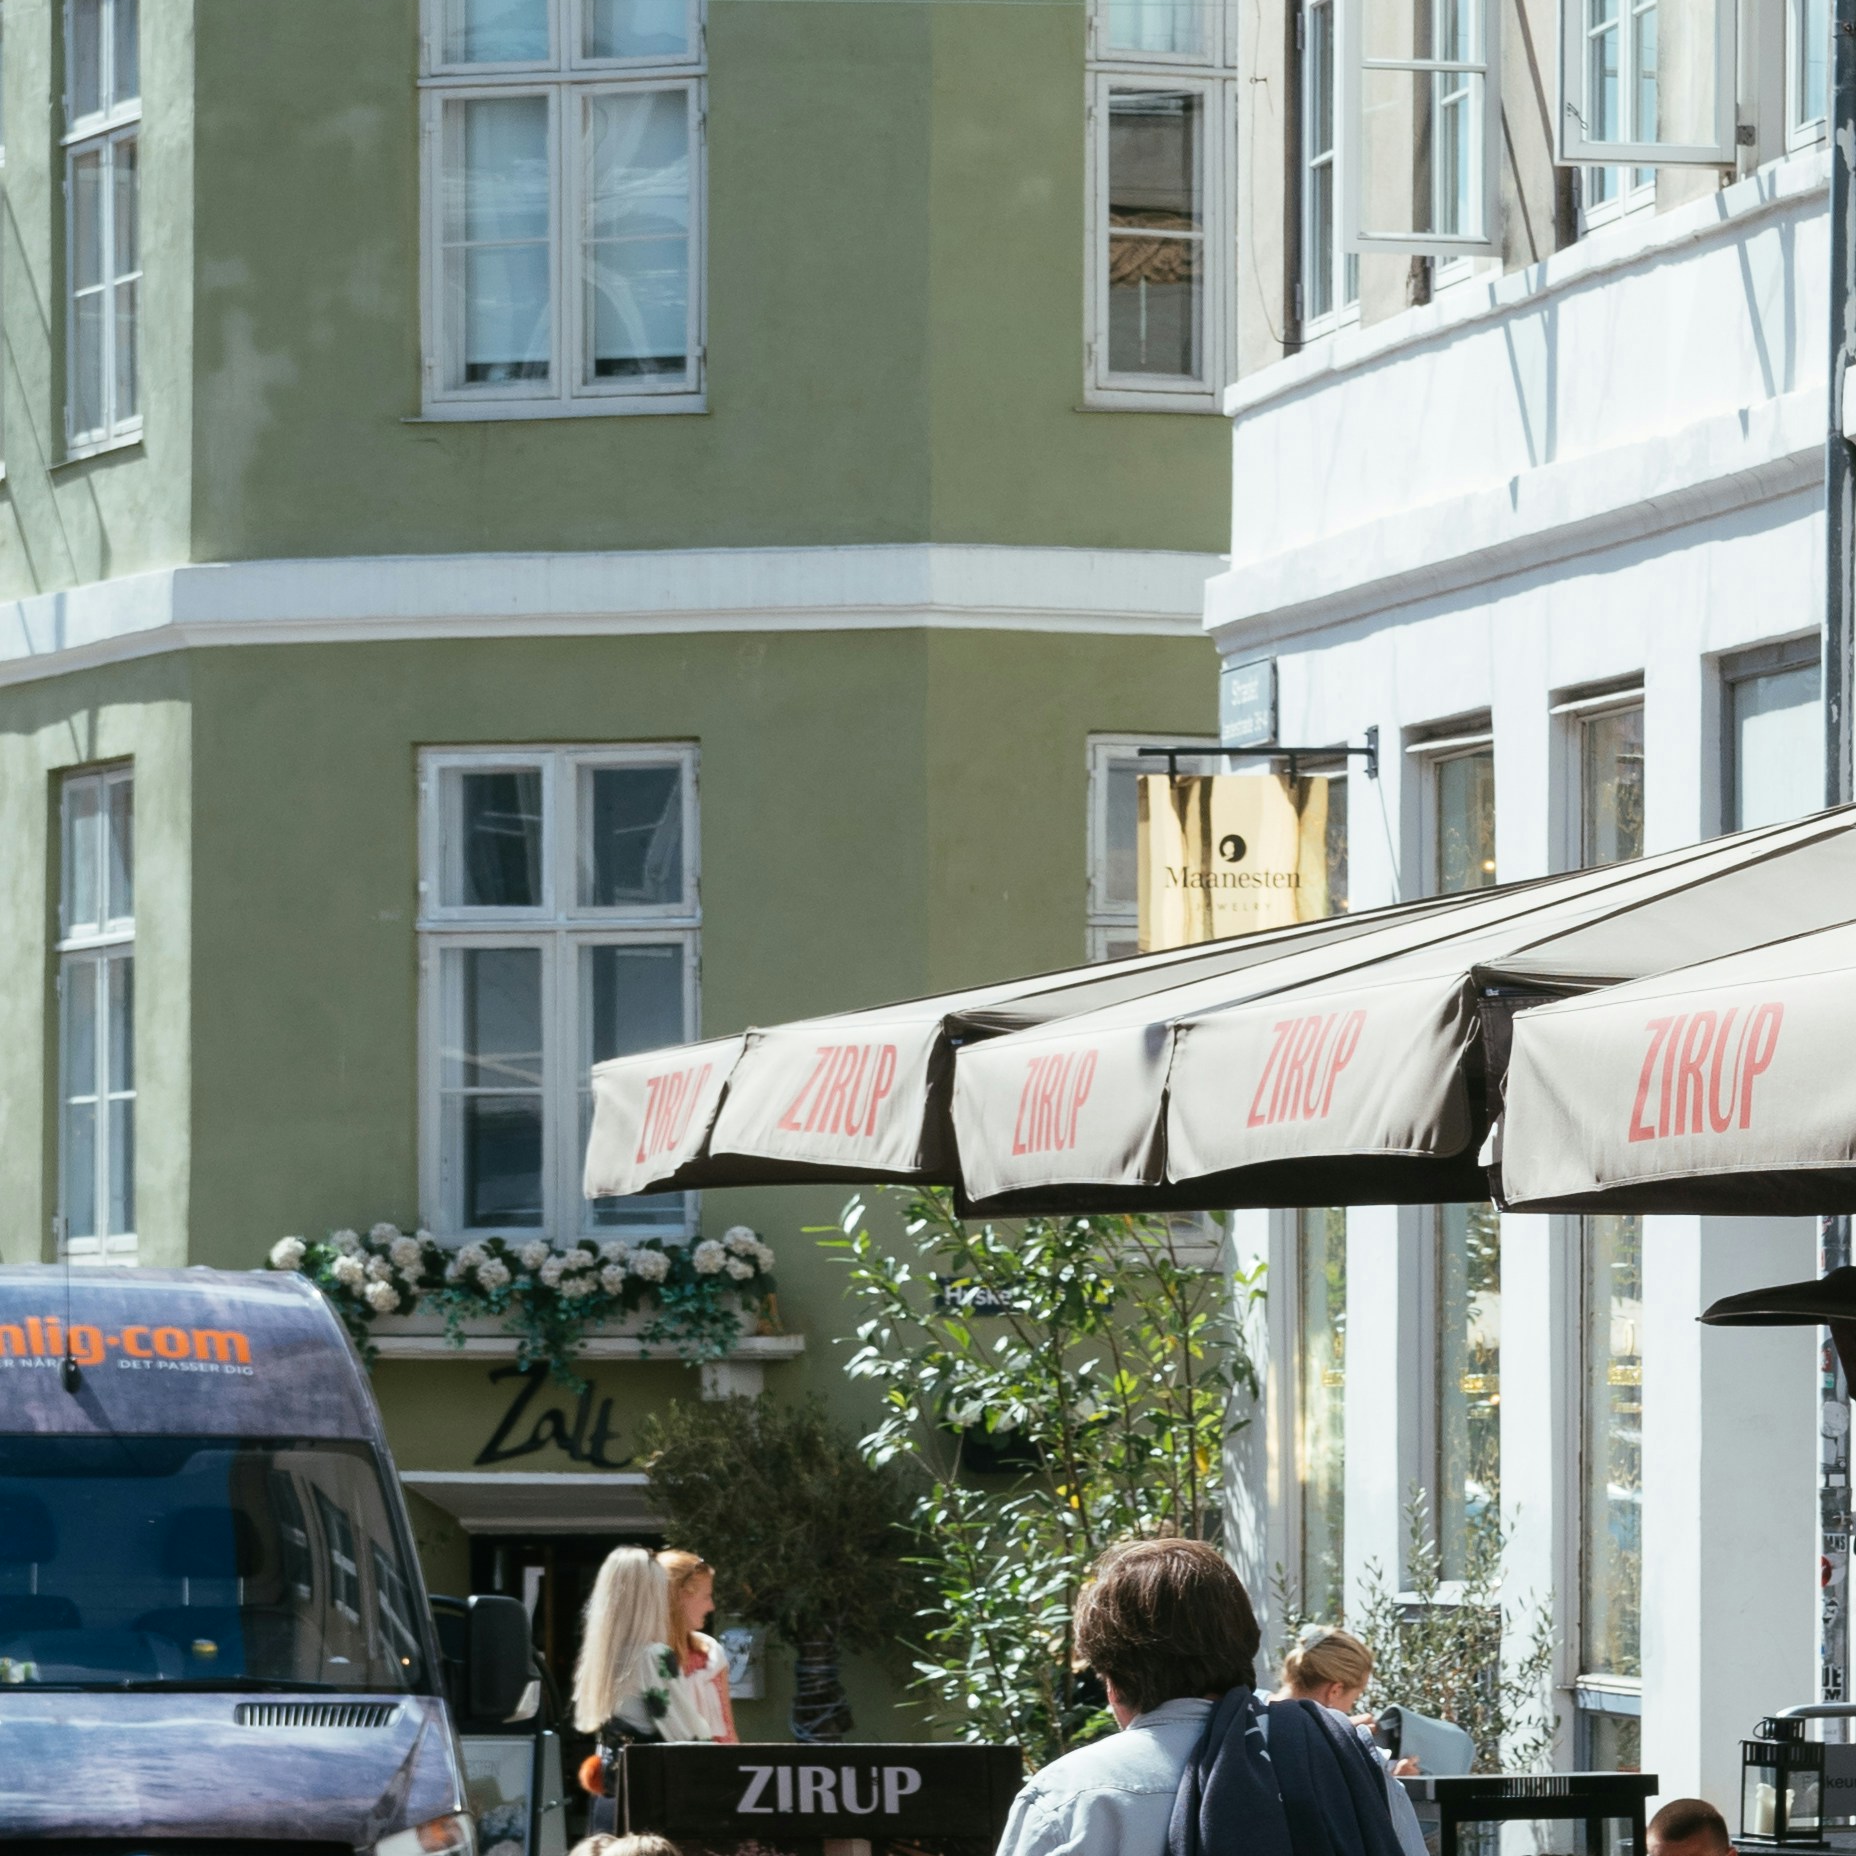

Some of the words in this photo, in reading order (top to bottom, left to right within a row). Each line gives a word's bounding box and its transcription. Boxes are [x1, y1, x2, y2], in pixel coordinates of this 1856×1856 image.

[1165, 866, 1302, 889] Maanesten
[634, 1061, 713, 1165] ZIRUP
[778, 1044, 899, 1138] ZIRUP
[1011, 1048, 1099, 1157] ZIRUP
[1246, 1009, 1369, 1129] ZIRUP
[1627, 1001, 1785, 1143] ZIRUP
[22, 1356, 57, 1368] NÅR
[117, 1358, 152, 1370] DET
[157, 1360, 220, 1374] PASSER
[224, 1364, 254, 1376] DIG
[474, 1360, 634, 1470] Zalt
[736, 1765, 922, 1814] ZIRUP
